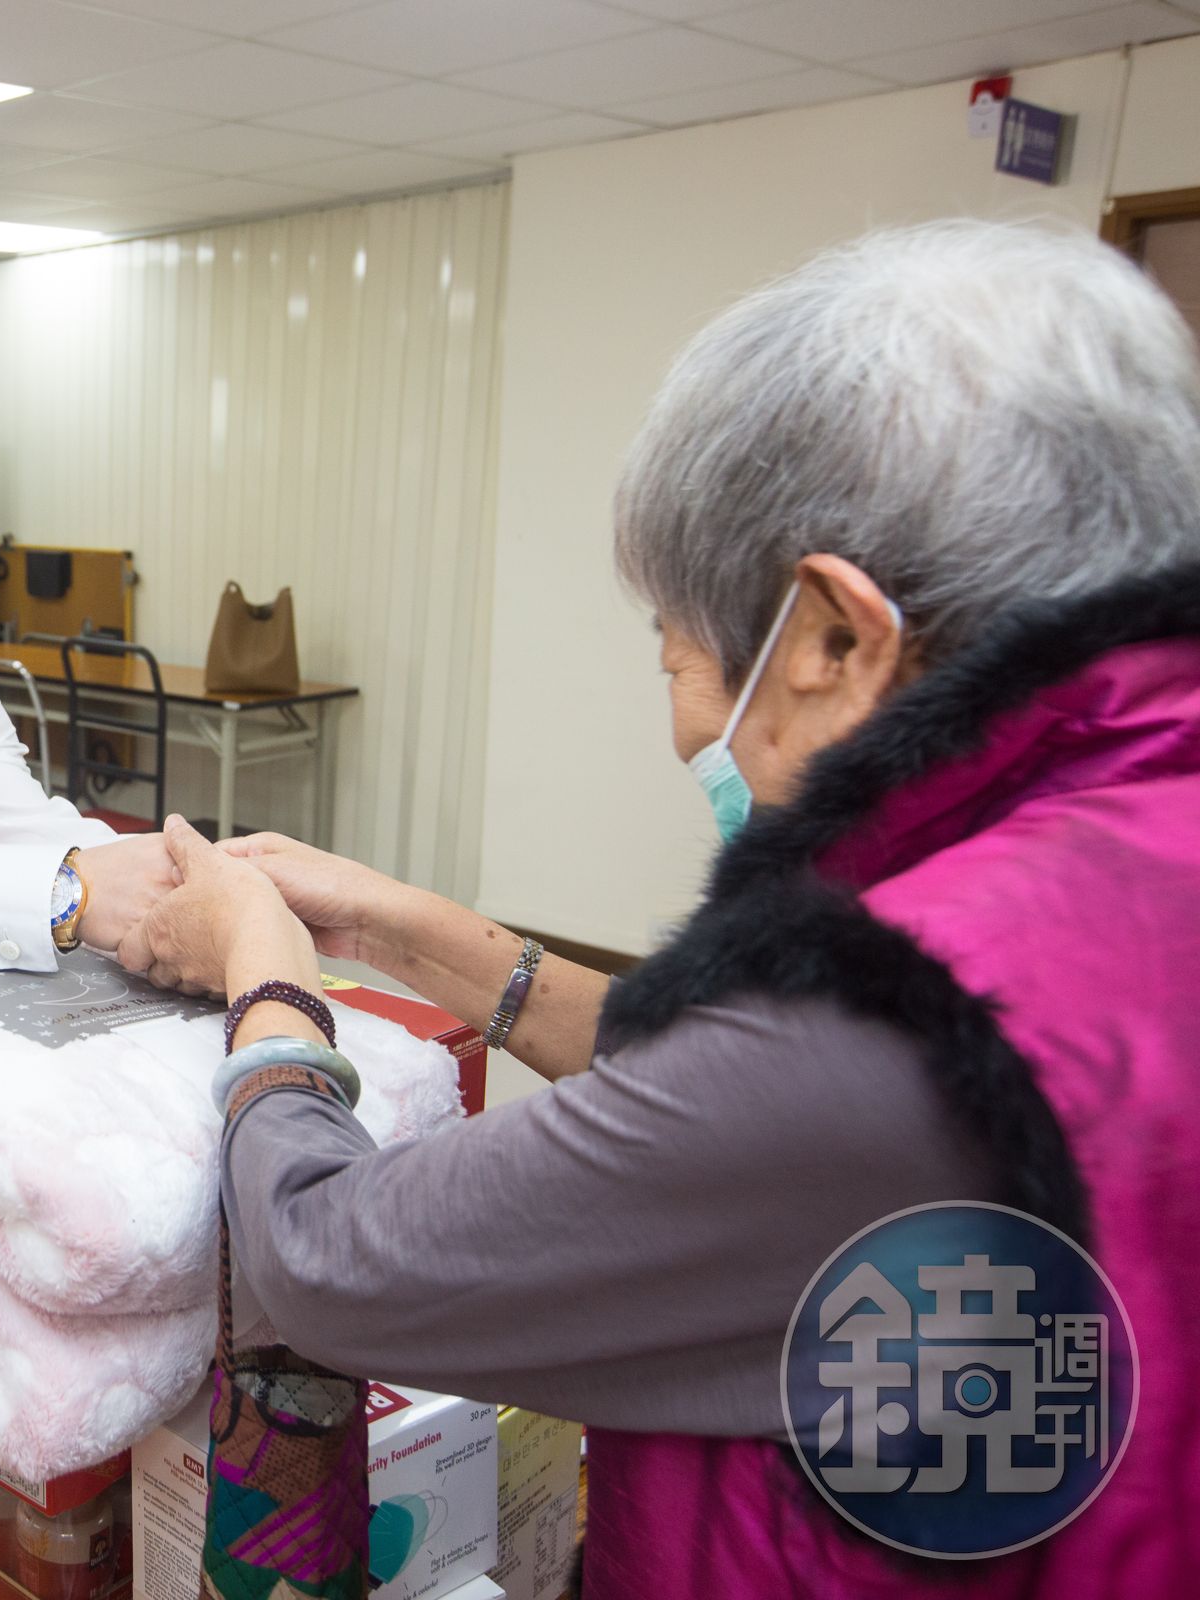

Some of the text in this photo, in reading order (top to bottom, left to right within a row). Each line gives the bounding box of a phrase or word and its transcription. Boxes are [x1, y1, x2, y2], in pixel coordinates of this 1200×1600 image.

[83, 1003, 129, 1015] Plush
[470, 1407, 491, 1422] 30 pcs
[391, 1431, 442, 1462] Foundation
